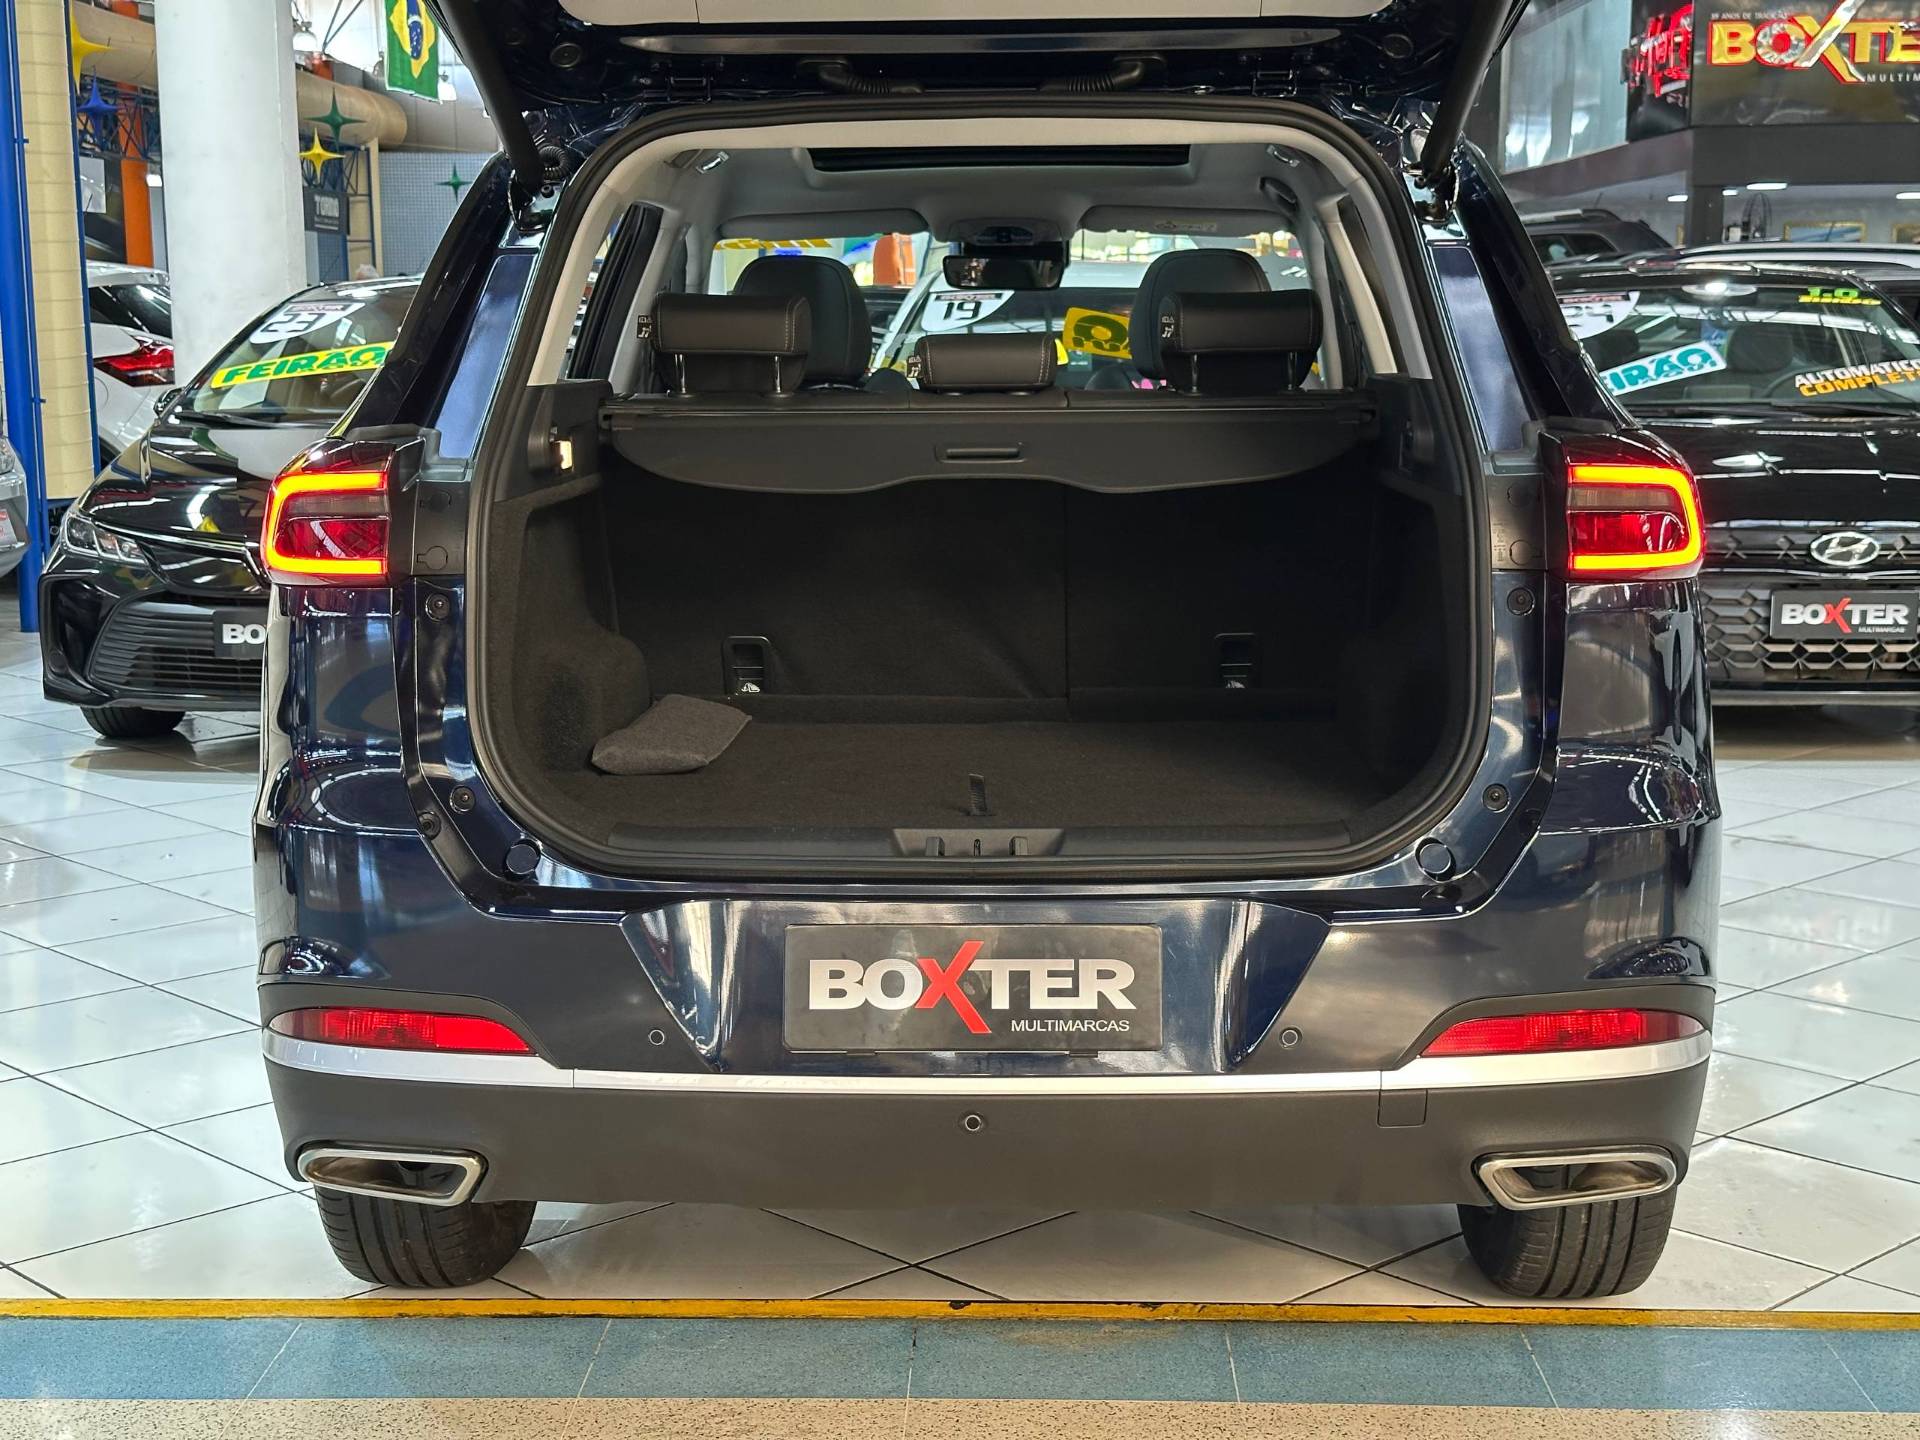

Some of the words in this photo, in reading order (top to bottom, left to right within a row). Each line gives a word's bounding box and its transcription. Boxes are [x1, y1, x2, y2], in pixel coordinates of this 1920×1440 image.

[1721, 12, 1741, 20] ANOS
[1742, 12, 1752, 20] DE
[943, 301, 982, 321] 19
[222, 346, 387, 383] FEIRÃO
[1781, 598, 1909, 633] BOXTER
[809, 940, 1137, 1034] BOXTER
[1010, 1019, 1130, 1032] MULTIMARCAS
